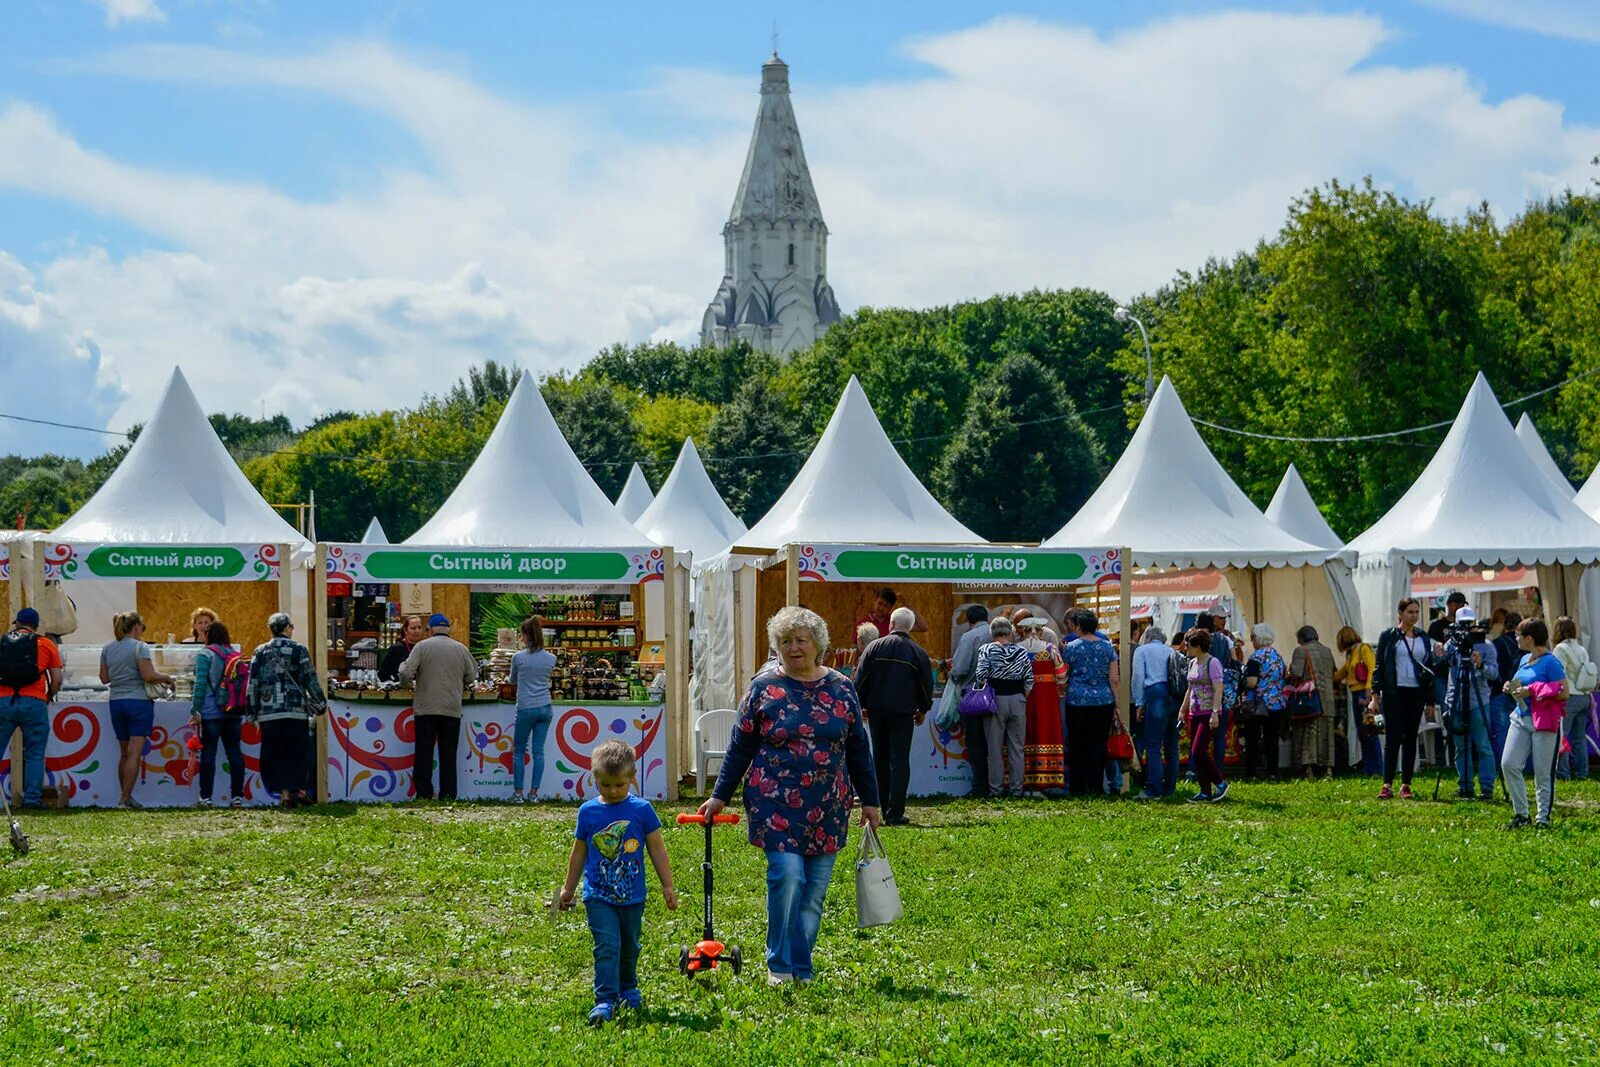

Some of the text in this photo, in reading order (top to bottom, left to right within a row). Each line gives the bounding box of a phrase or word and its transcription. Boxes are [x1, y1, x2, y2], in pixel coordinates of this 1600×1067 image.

[108, 552, 225, 570] Сытный двор
[429, 554, 567, 574] Сытный двор
[896, 554, 1027, 574] Сытный двор
